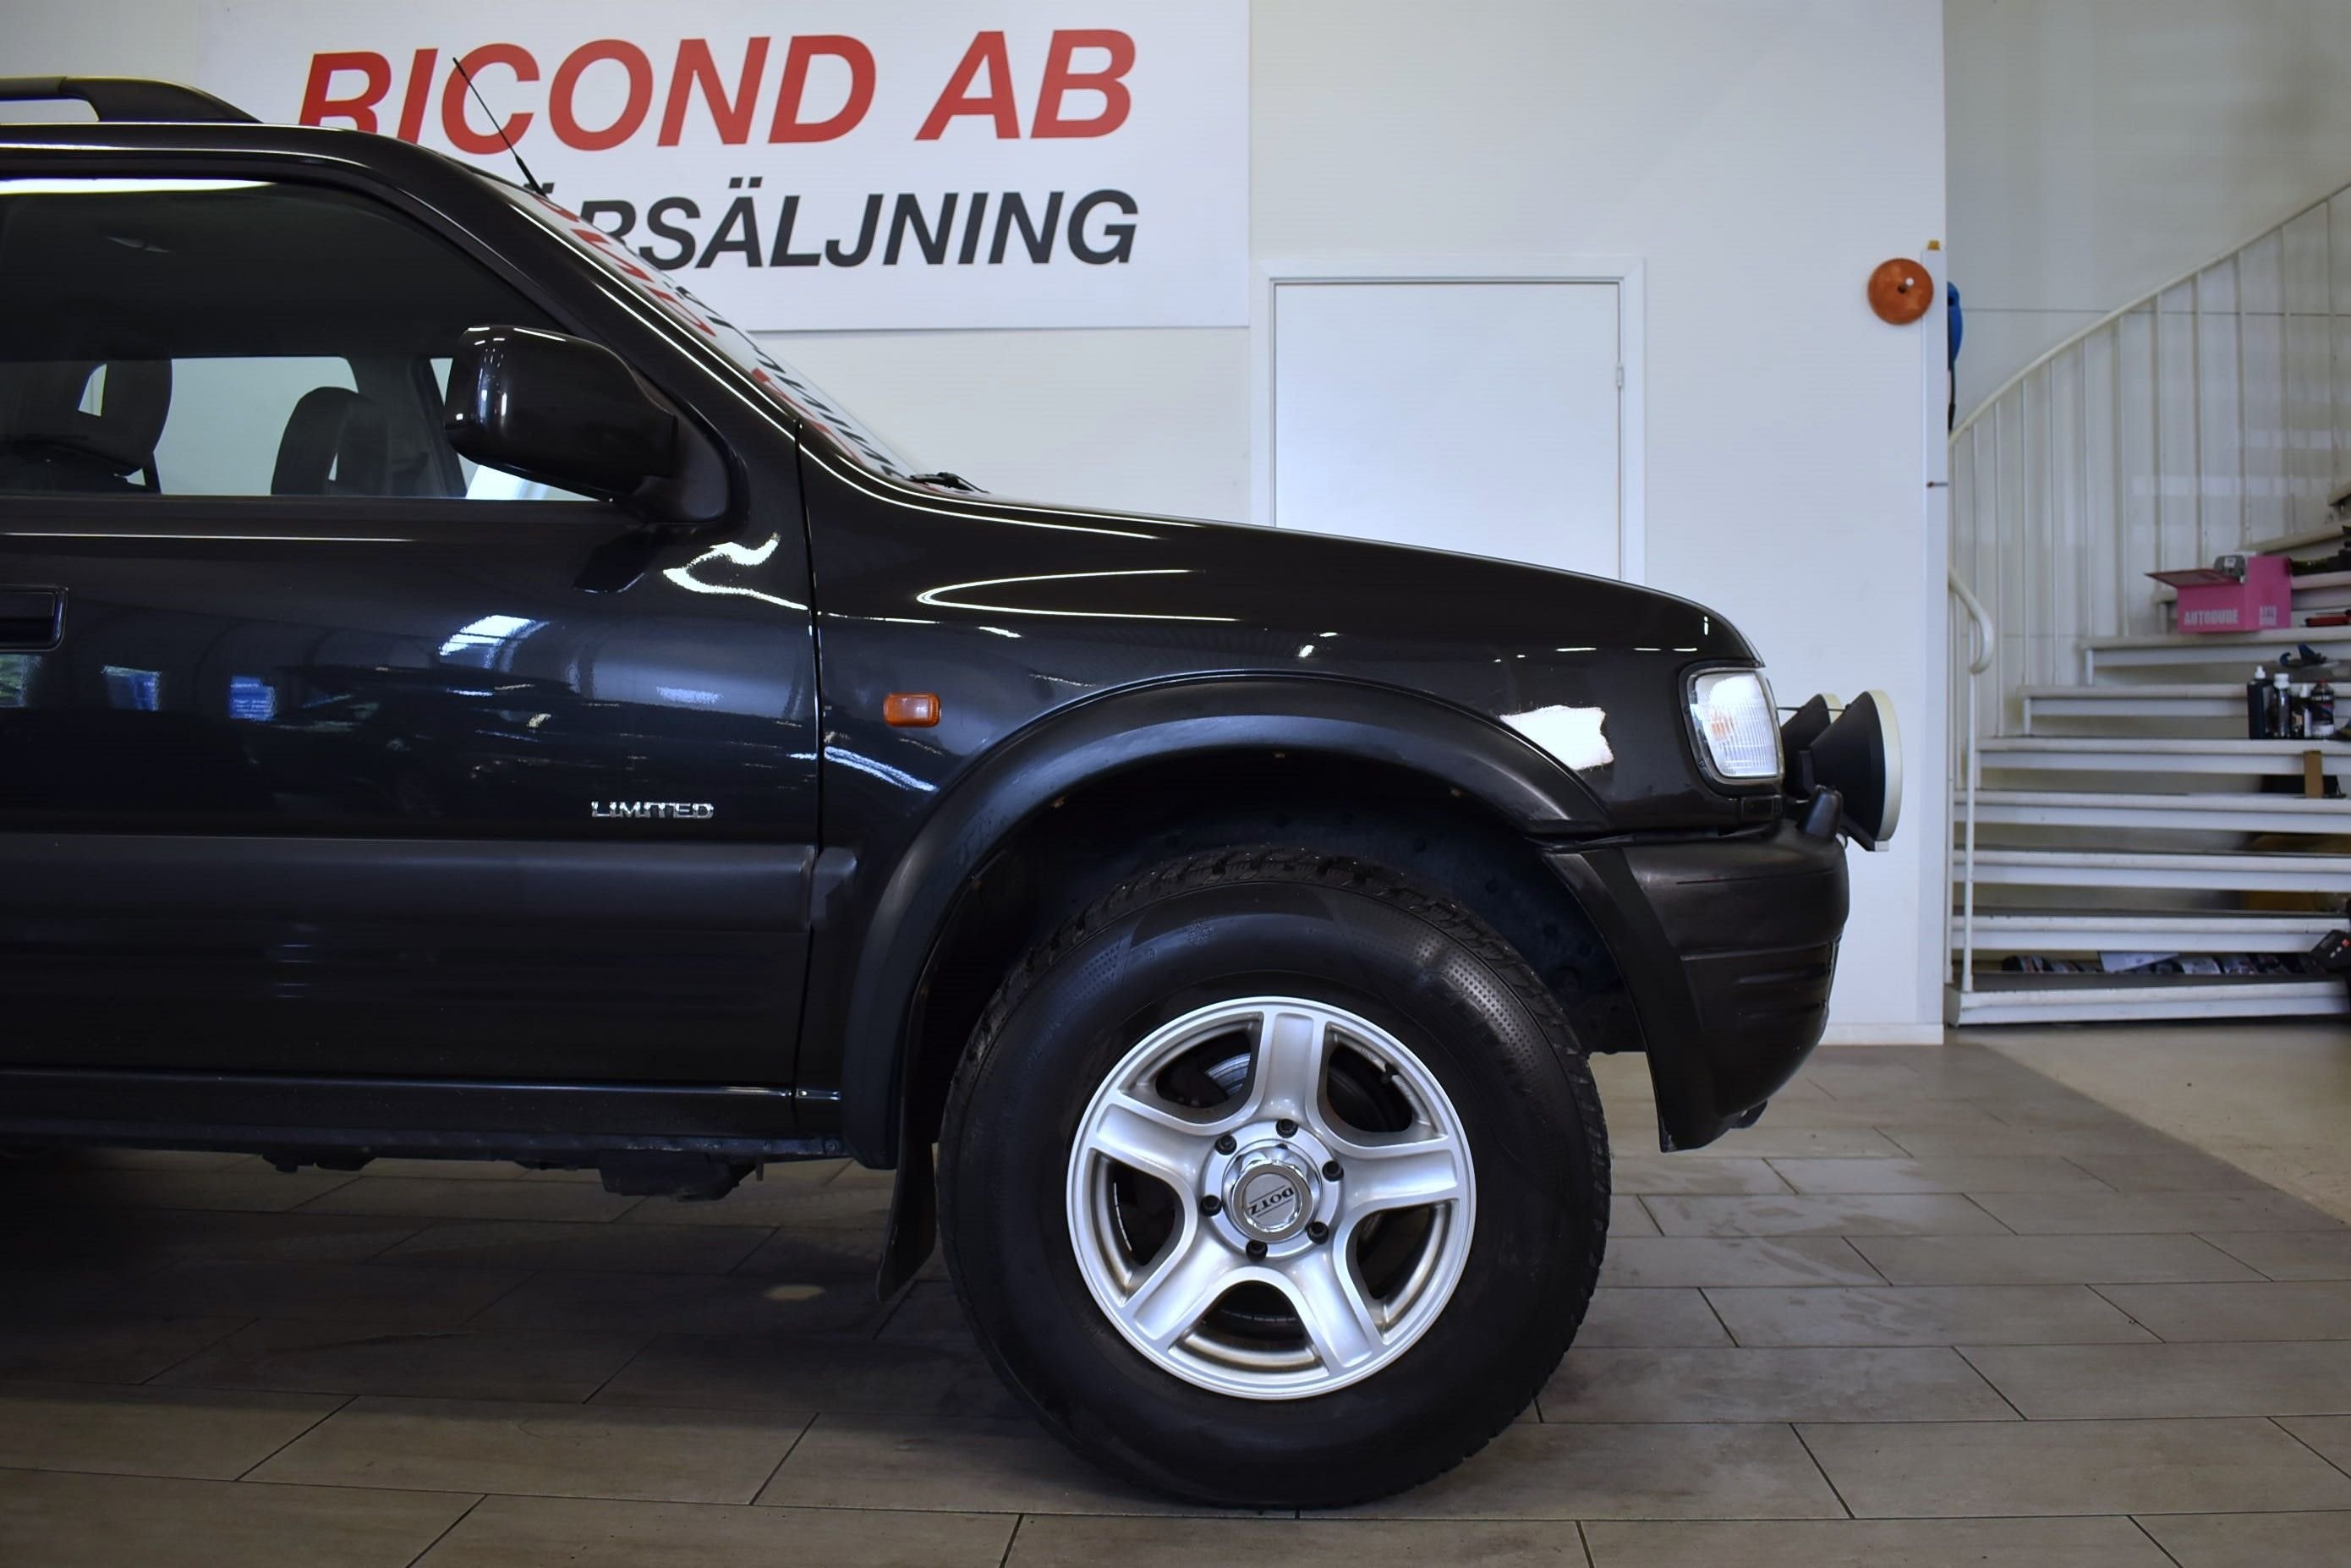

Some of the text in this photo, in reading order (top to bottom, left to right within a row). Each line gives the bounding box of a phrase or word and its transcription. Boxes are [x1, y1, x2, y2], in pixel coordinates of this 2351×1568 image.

[917, 30, 1136, 141] AB
[591, 801, 715, 819] LIMITED
[1247, 1187, 1294, 1215] DOTZ
